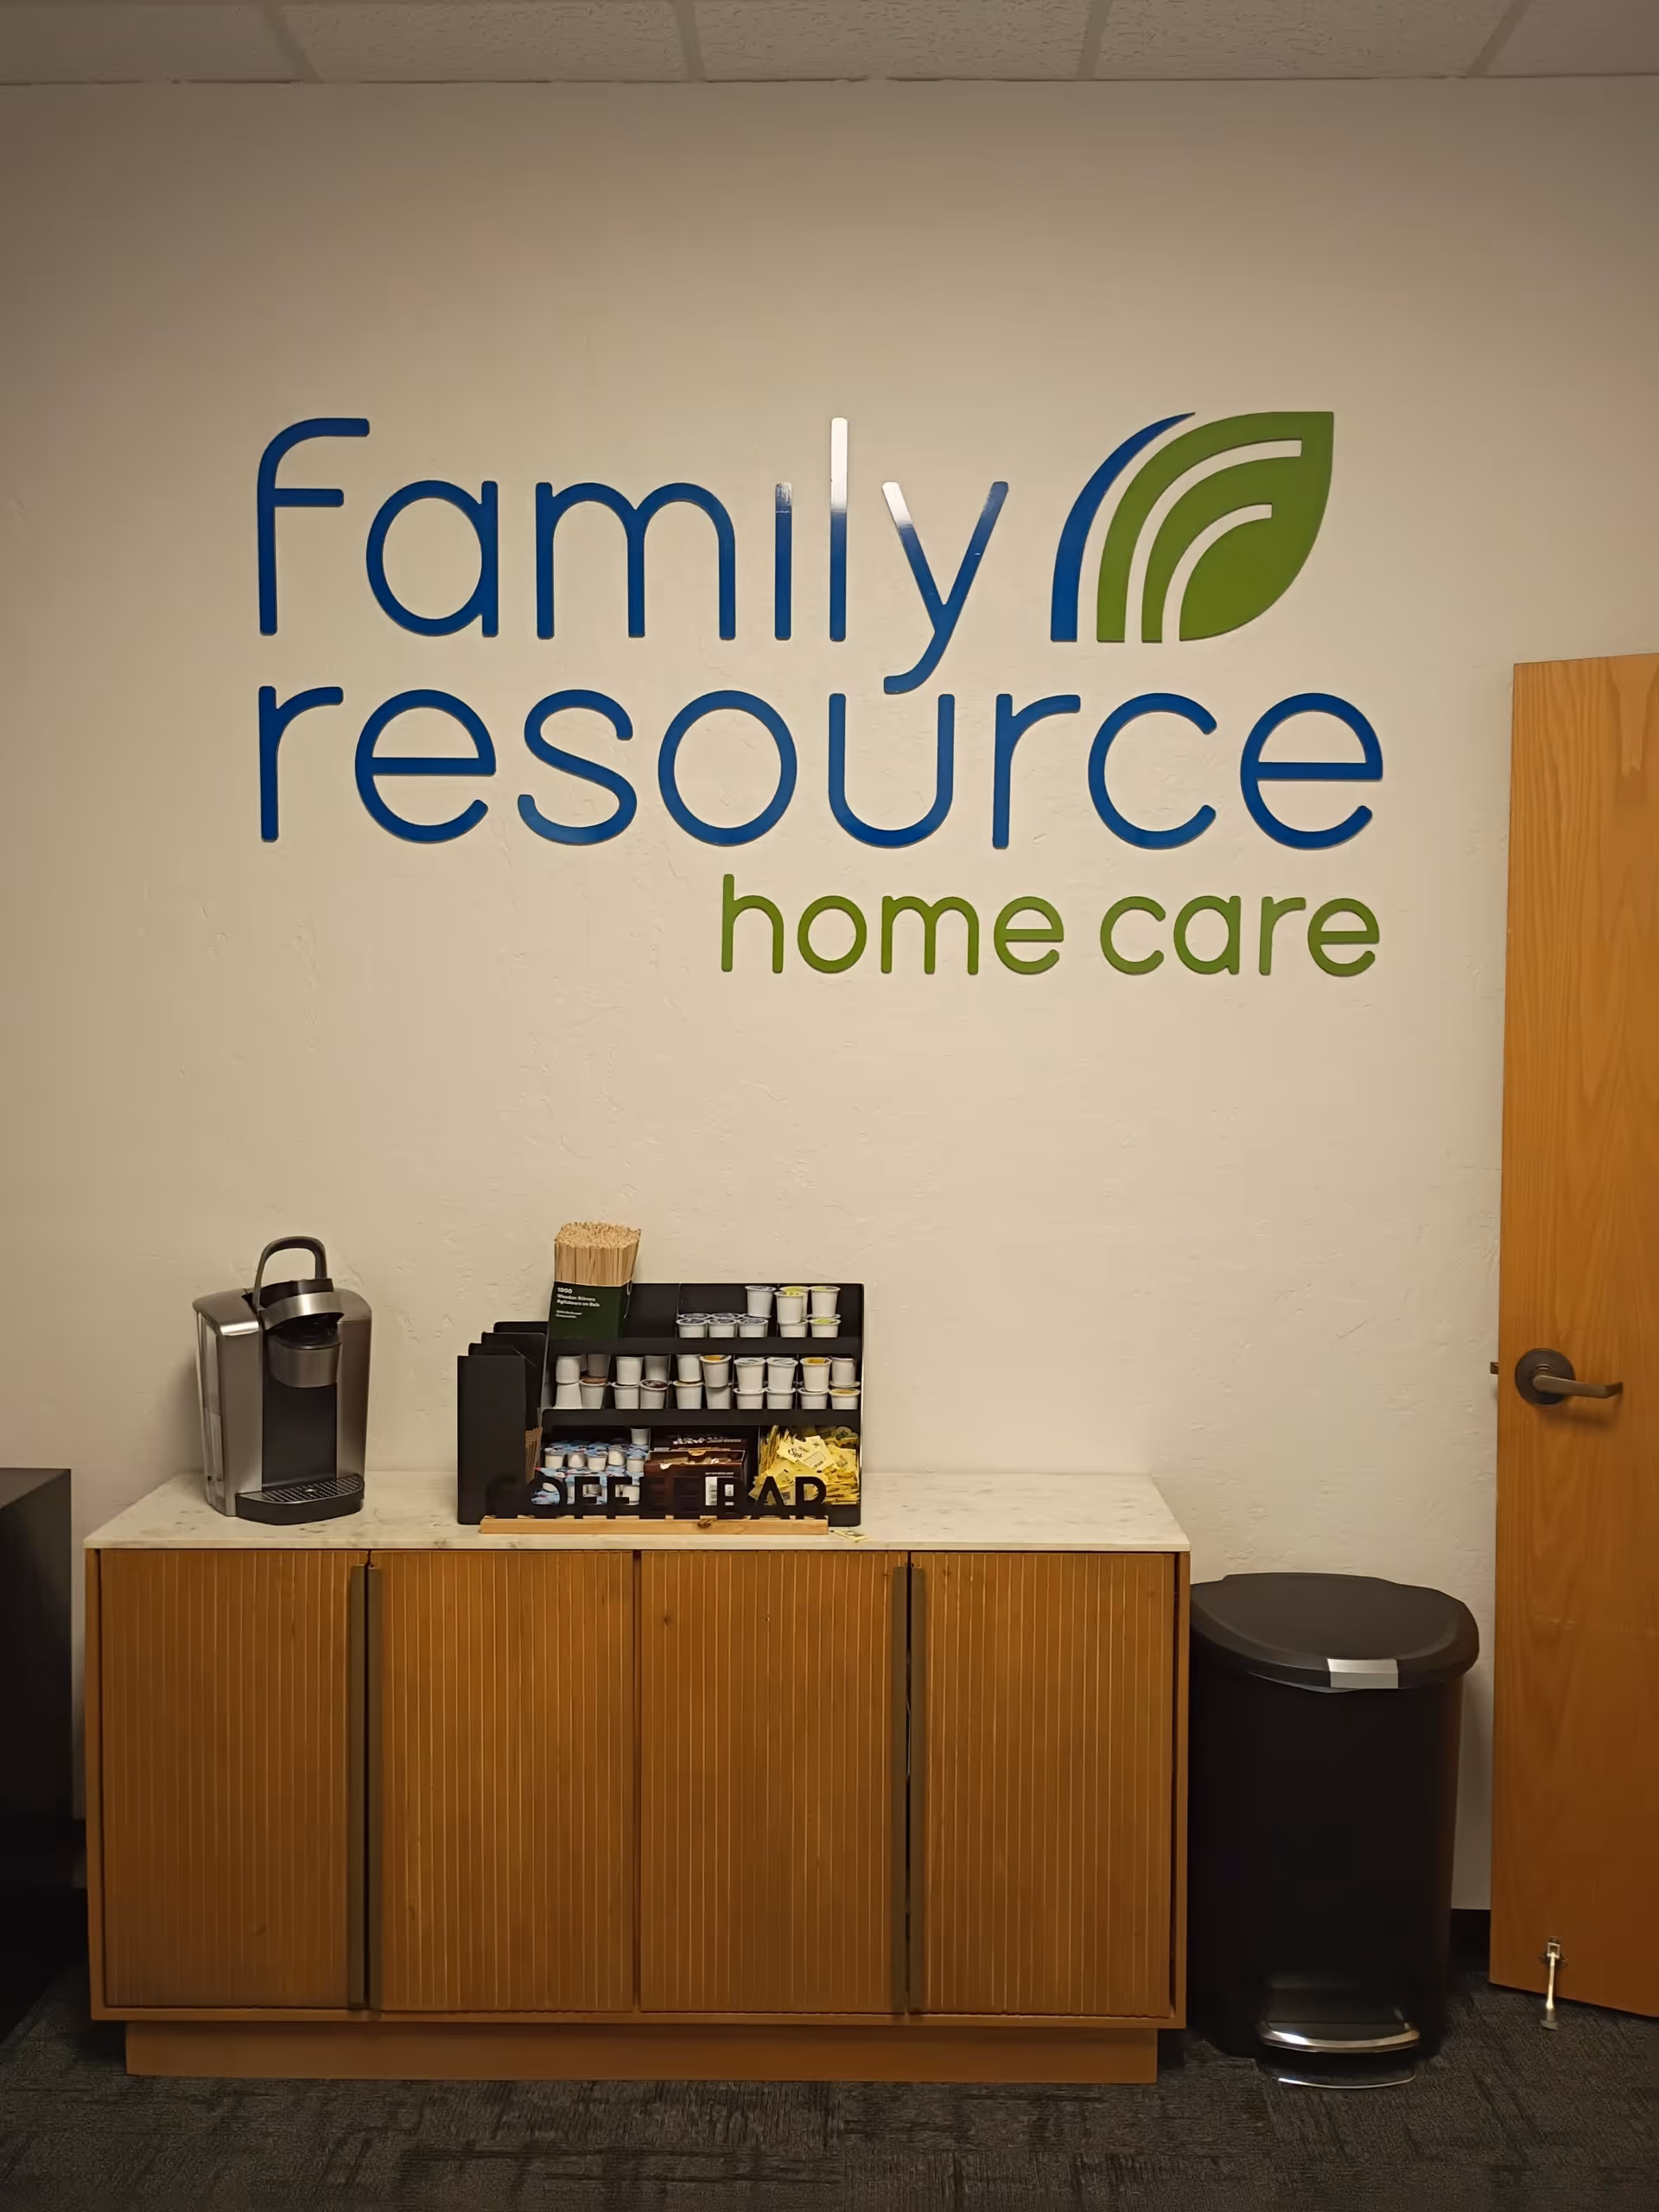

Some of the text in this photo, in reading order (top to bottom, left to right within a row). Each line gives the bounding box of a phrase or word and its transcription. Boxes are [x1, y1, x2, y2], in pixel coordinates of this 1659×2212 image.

[257, 415, 1009, 696] family
[257, 684, 1384, 850] resource
[721, 874, 1379, 974] home care
